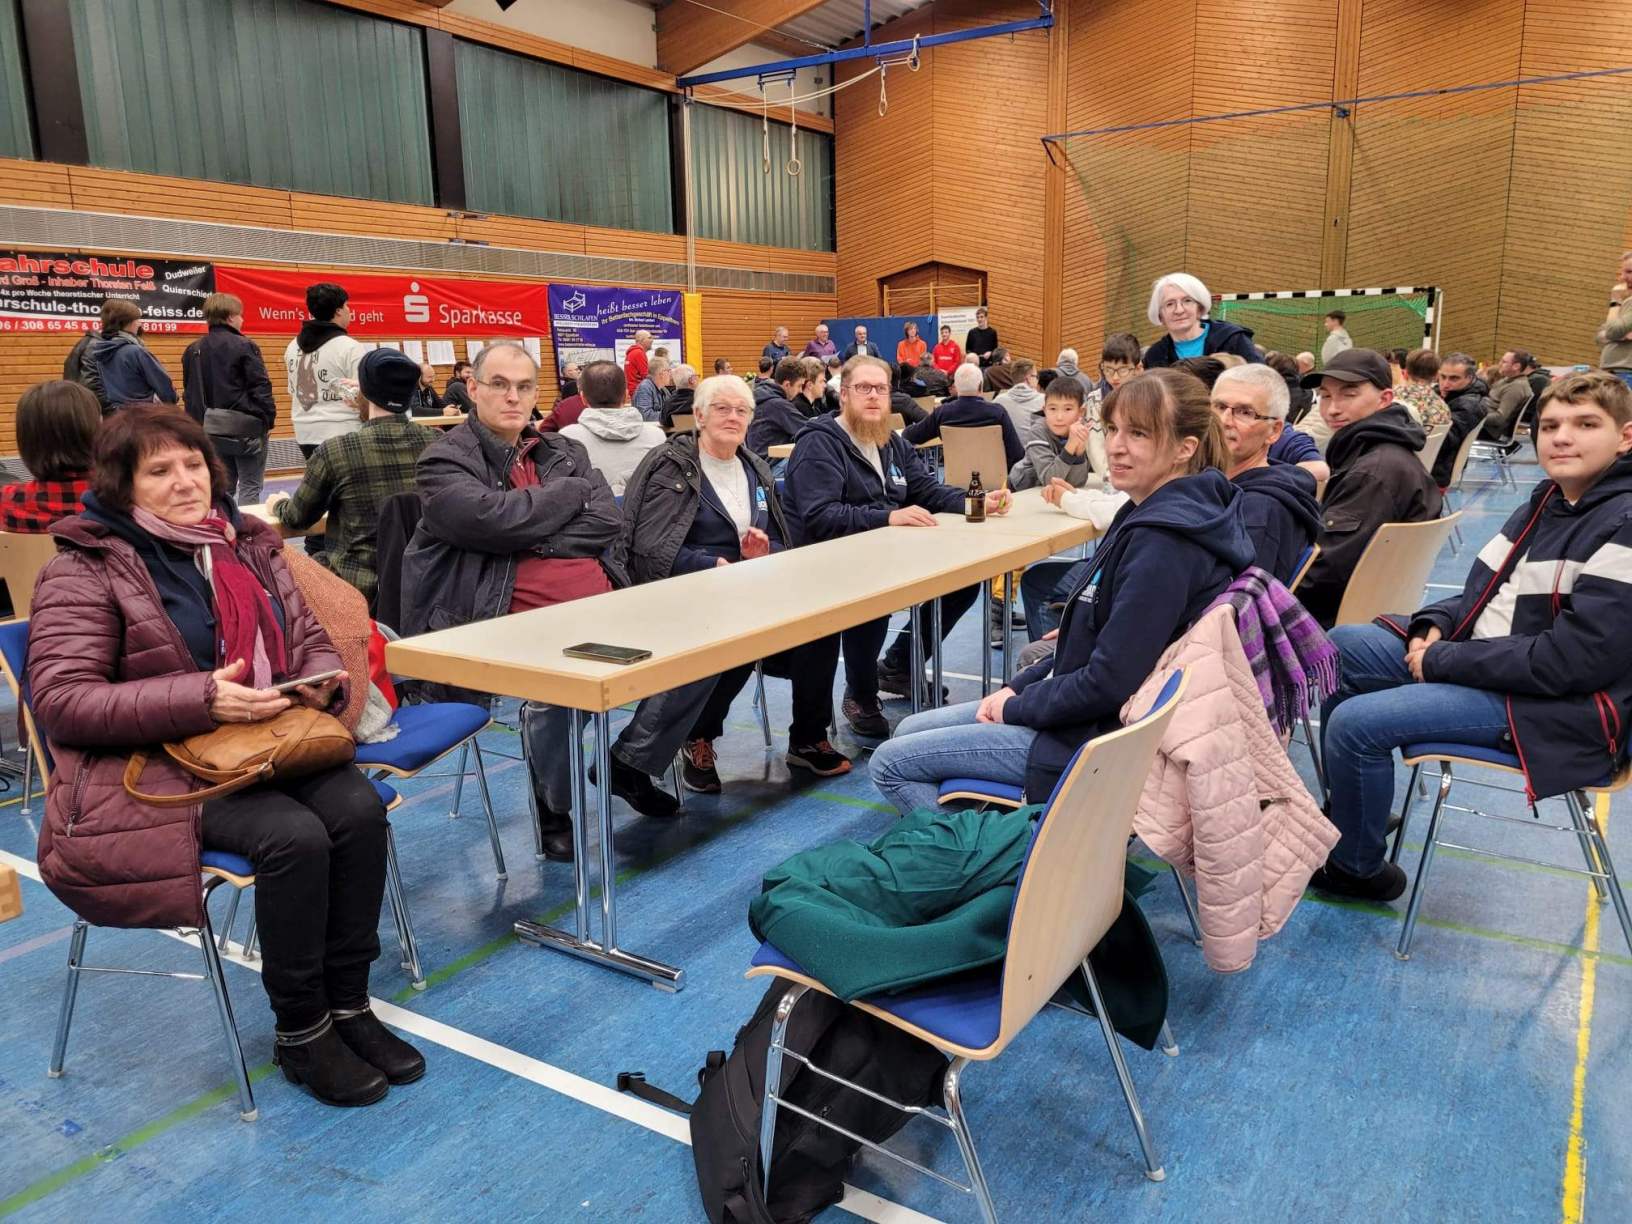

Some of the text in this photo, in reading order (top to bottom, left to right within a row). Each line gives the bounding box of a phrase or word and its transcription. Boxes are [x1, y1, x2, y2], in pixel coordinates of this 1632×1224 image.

[165, 265, 206, 280] Dudweiler
[48, 276, 89, 288] Inhaber
[89, 278, 133, 290] Thorsten
[1, 288, 10, 297] 4x
[26, 289, 52, 297] Woche
[53, 290, 104, 299] theoretischer
[105, 292, 140, 300] Unterricht
[622, 299, 648, 311] besser
[651, 294, 672, 306] leben
[259, 306, 305, 320] Wenn's
[359, 311, 384, 325] geht
[439, 304, 522, 328] Sparkasse
[22, 320, 44, 330] 308
[47, 321, 61, 331] 65
[64, 321, 79, 331] 45
